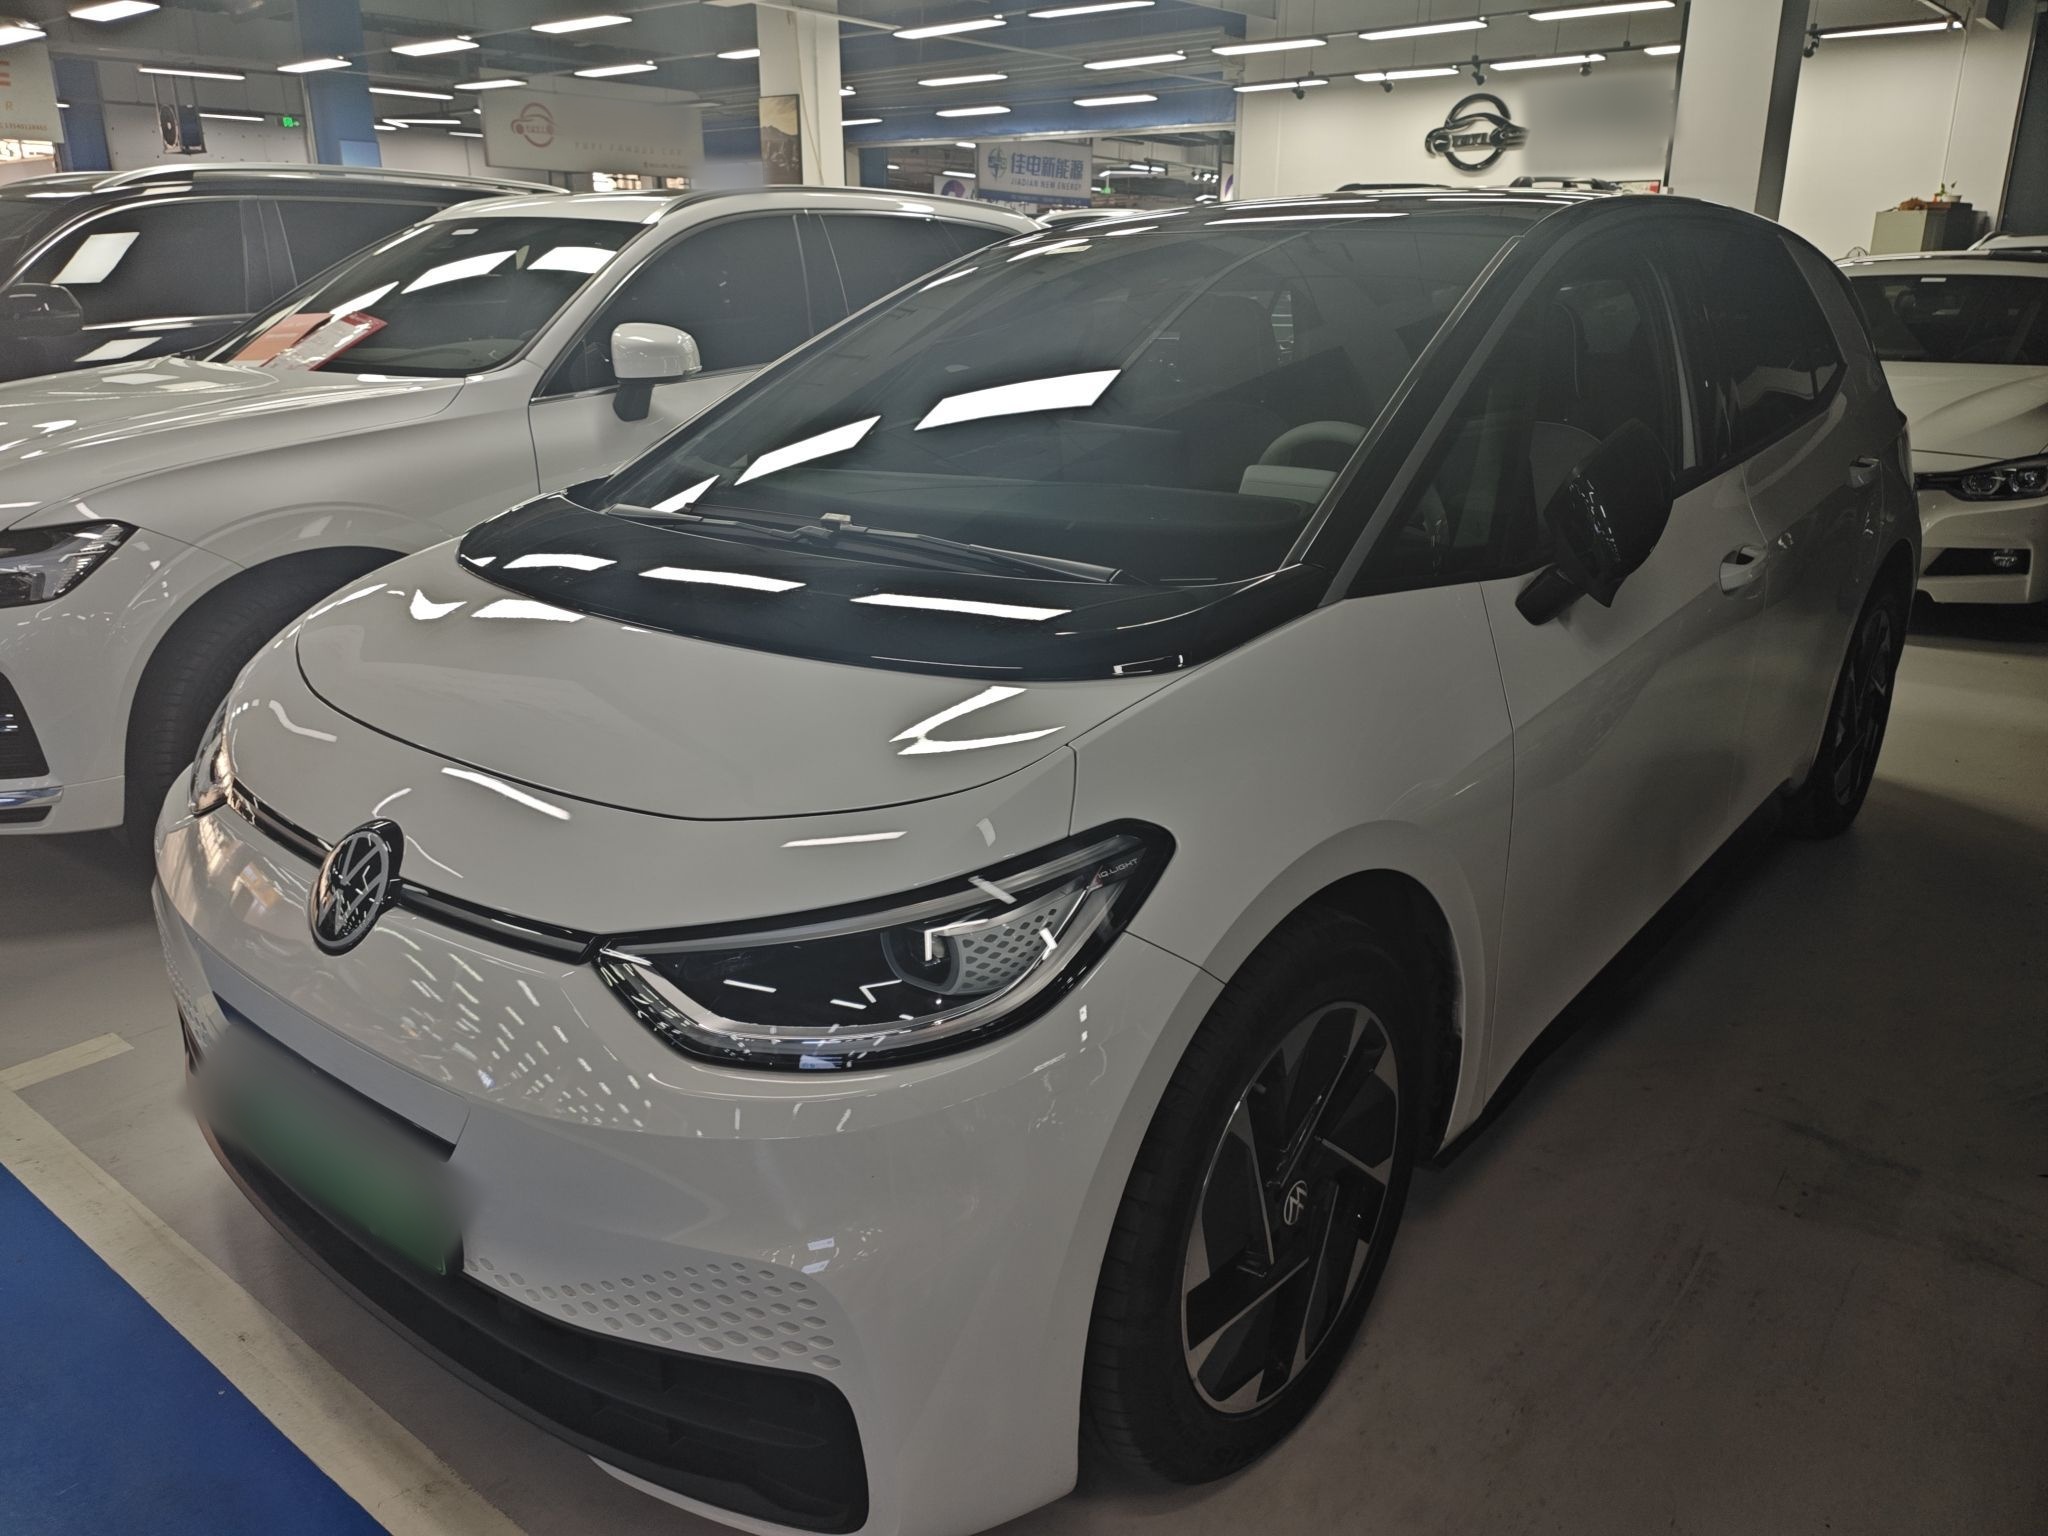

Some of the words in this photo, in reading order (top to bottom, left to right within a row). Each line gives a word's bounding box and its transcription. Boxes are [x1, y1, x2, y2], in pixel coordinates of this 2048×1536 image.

[1011, 152, 1083, 180] 佳电新能源
